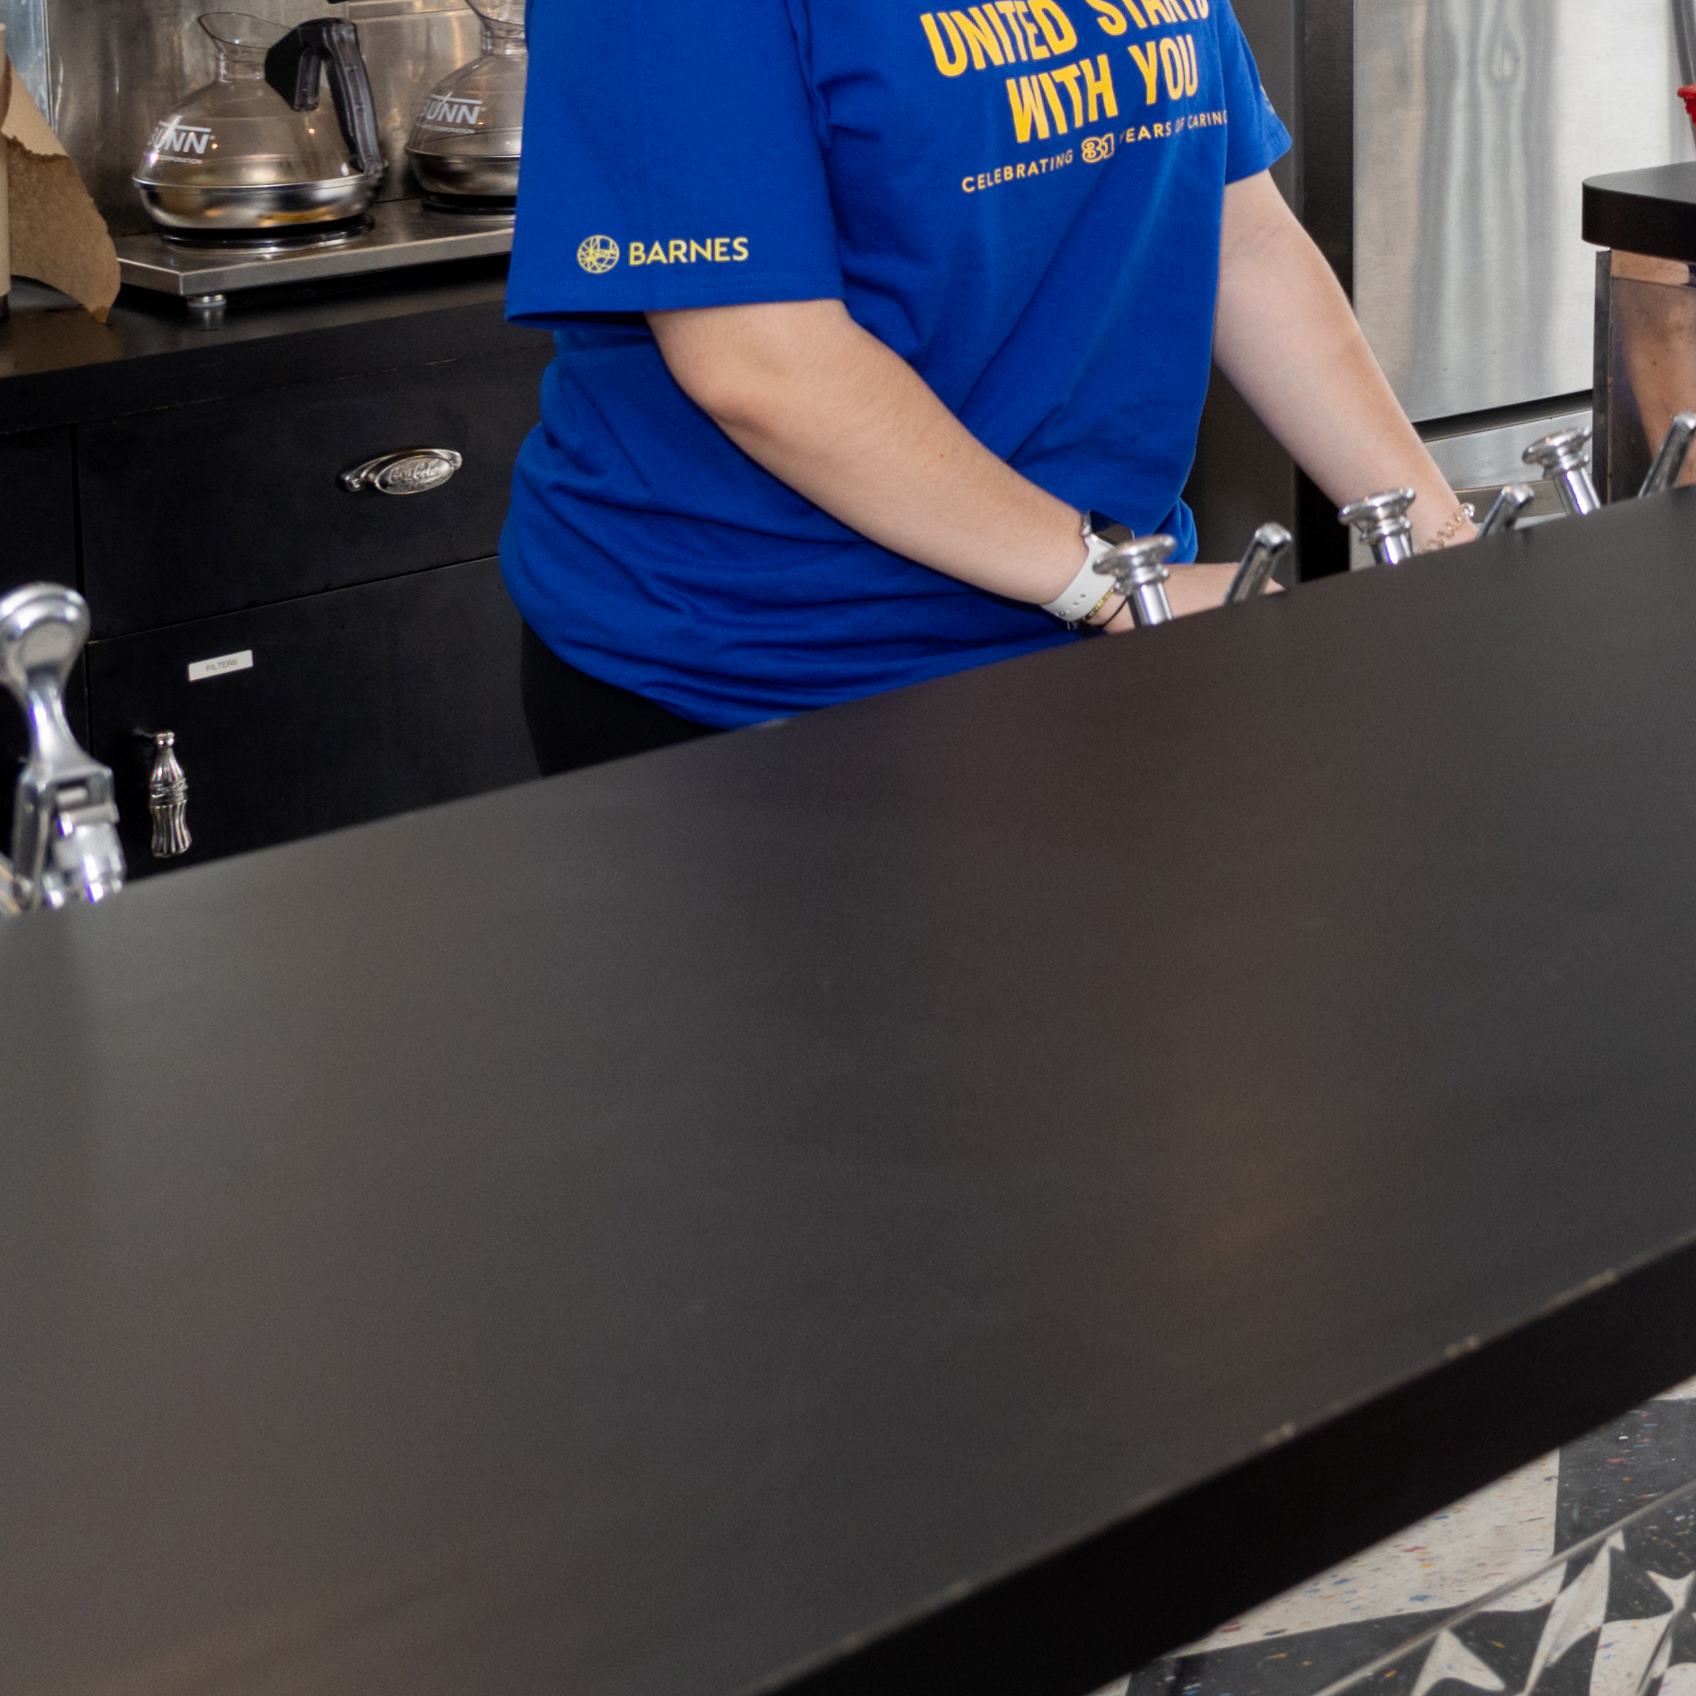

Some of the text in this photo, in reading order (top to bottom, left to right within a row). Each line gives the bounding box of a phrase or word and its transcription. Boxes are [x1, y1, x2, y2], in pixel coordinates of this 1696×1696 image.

[1005, 33, 1199, 144] WITH YOU
[961, 149, 1074, 194] CELEBRATING
[628, 236, 749, 266] BARNES
[206, 658, 239, 673] FILTERS
